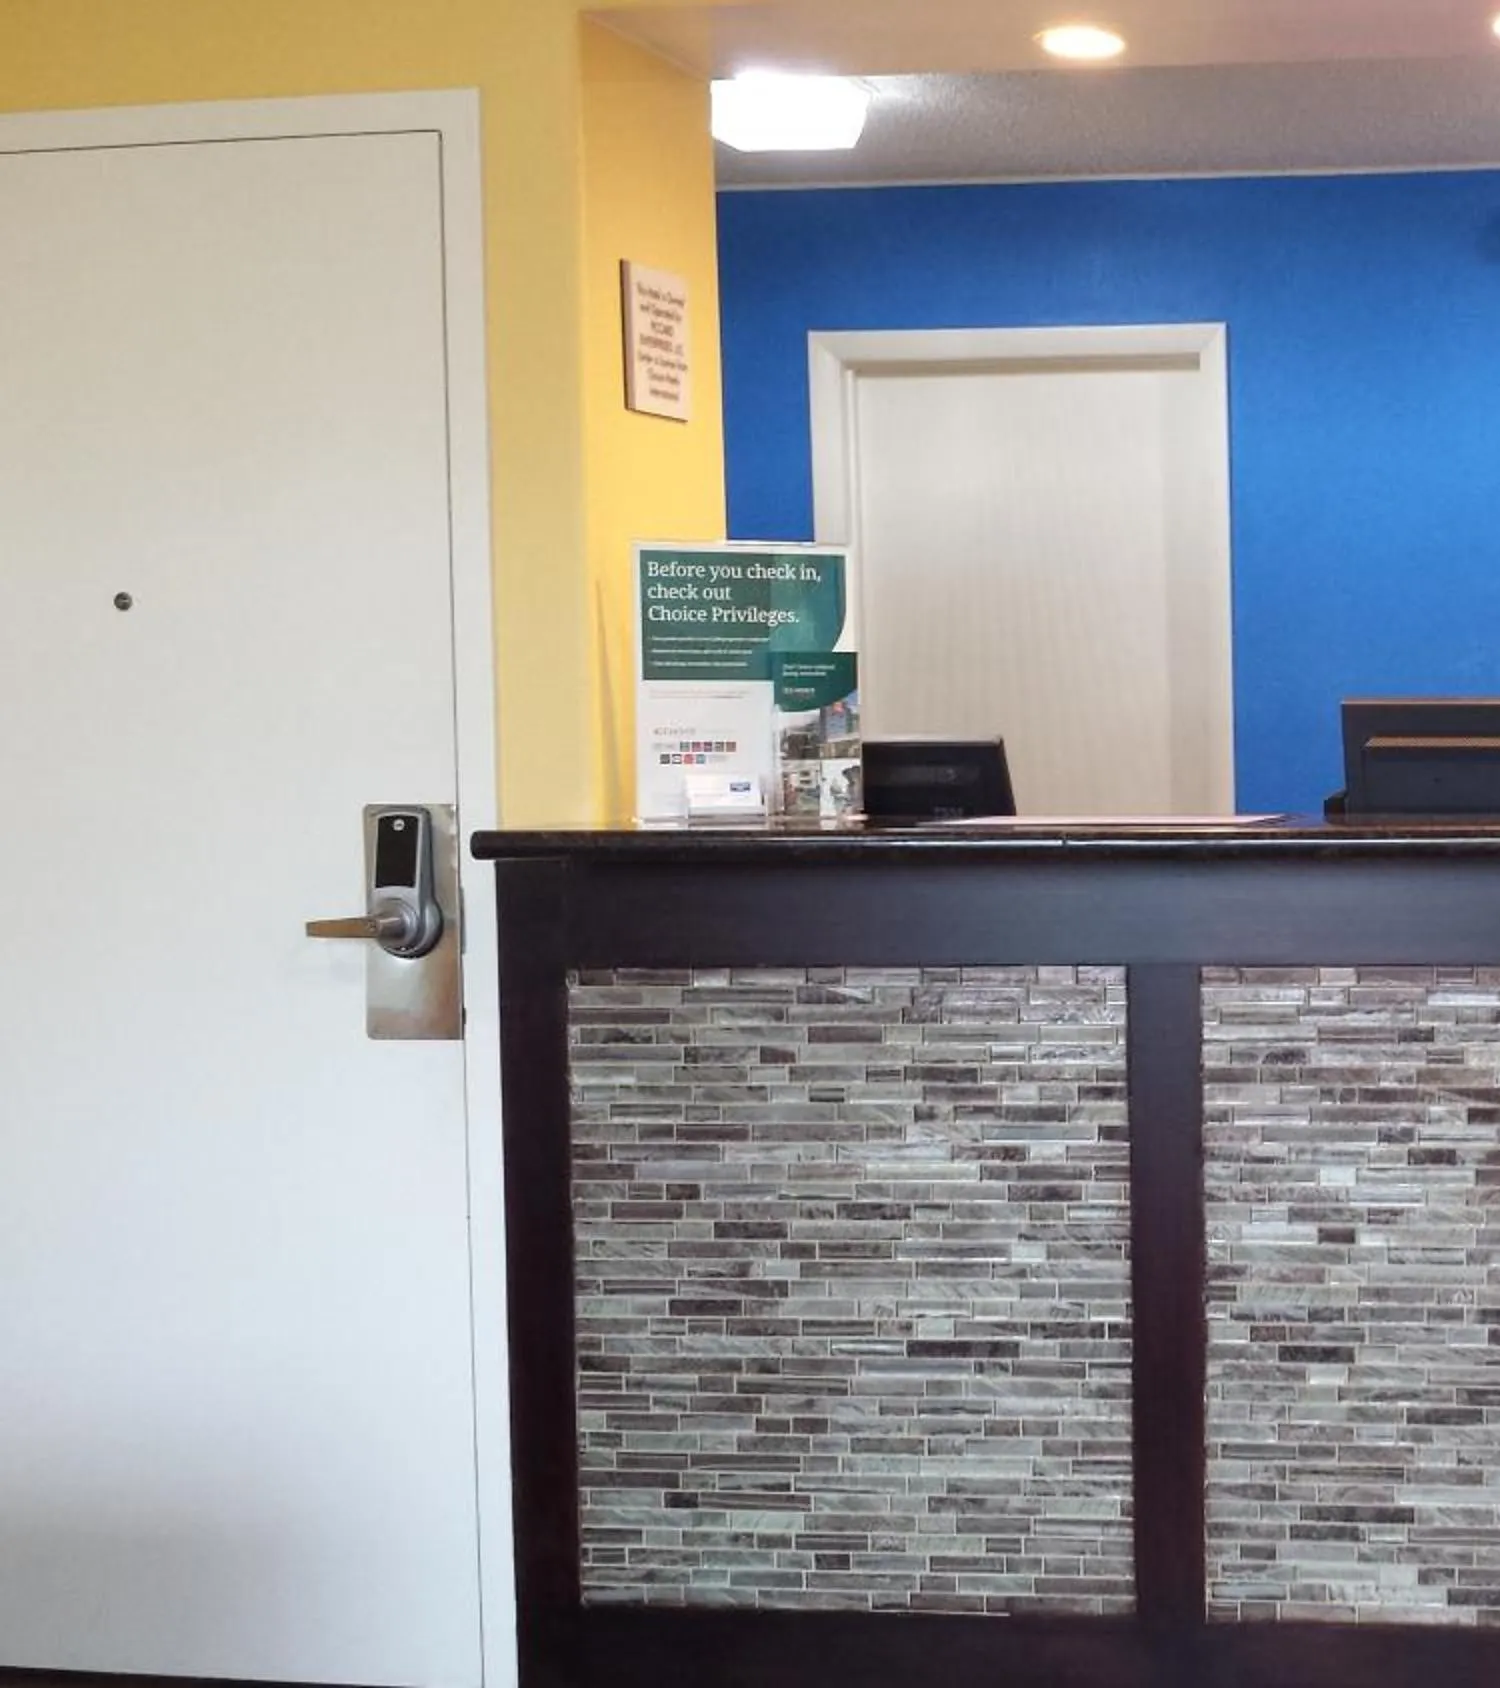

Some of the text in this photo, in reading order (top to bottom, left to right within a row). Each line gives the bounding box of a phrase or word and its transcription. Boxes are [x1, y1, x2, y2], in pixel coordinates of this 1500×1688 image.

[647, 561, 821, 582] Before you check in,
[647, 583, 732, 600] check out
[648, 605, 800, 626] Choice Privileges.
